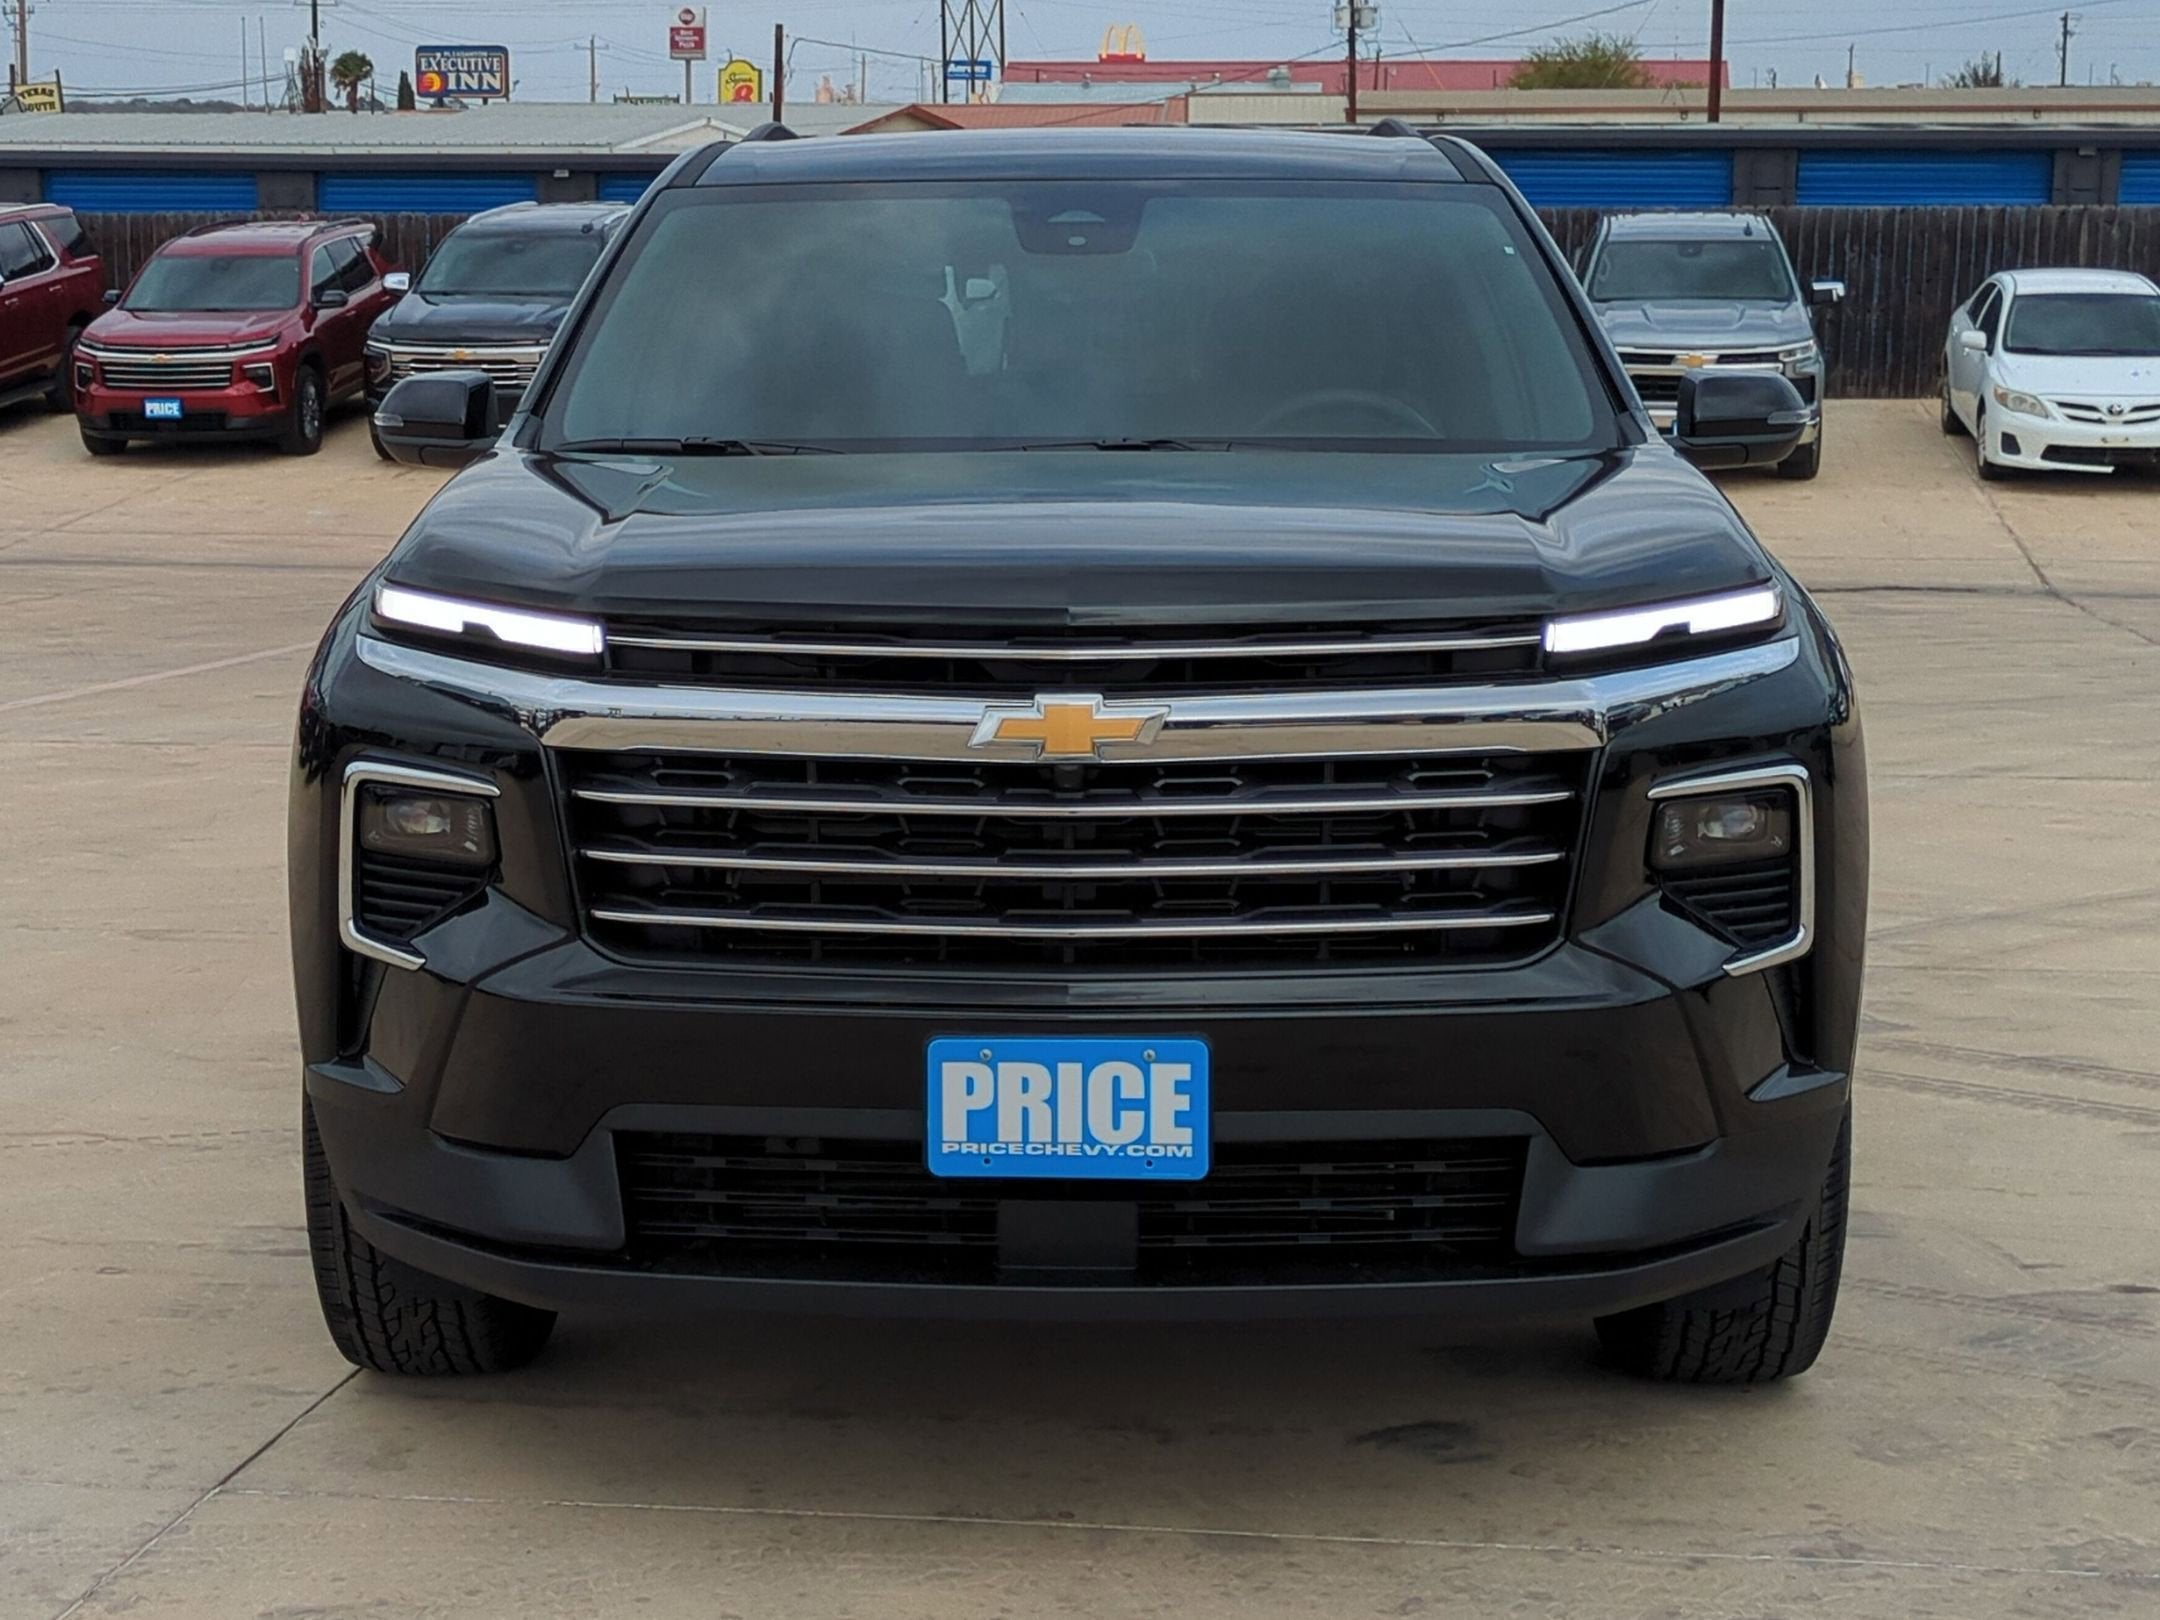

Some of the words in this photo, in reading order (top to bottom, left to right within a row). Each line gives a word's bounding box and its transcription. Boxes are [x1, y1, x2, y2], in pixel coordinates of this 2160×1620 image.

[421, 53, 500, 71] EXECUTIVE
[447, 72, 501, 90] INN
[17, 87, 54, 100] TEXAS
[145, 402, 180, 416] PRICE
[942, 1061, 1193, 1144] PRICE
[941, 1143, 1193, 1158] PRICECHEVY.COM
